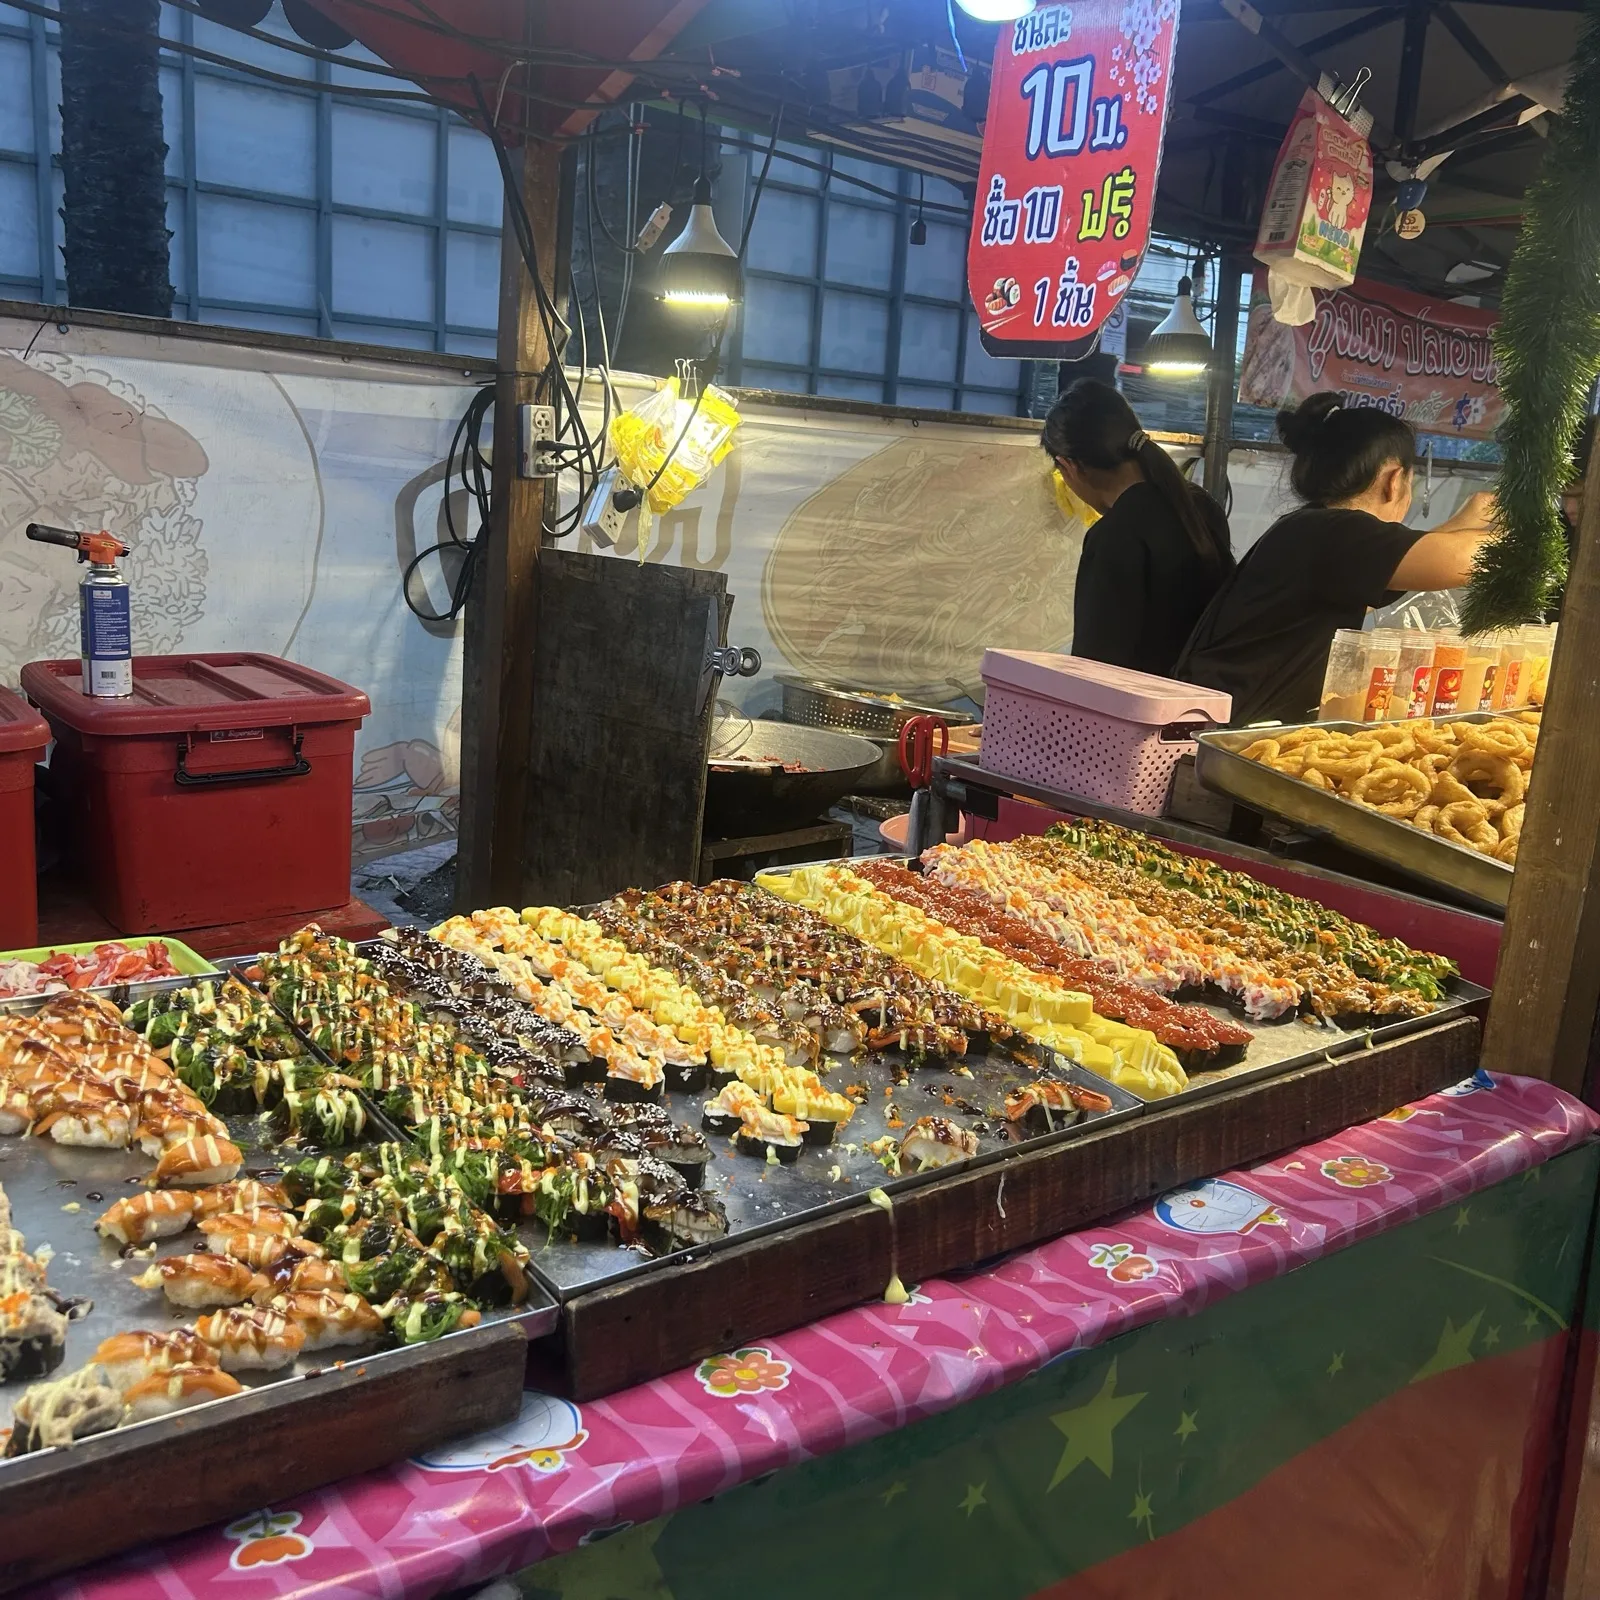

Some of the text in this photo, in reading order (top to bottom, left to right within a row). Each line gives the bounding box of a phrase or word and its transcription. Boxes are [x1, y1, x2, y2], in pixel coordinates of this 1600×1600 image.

[1013, 5, 1072, 54] ชนละ
[1022, 59, 1092, 157] 10
[1024, 186, 1062, 243] 10
[1078, 167, 1135, 242] ฟรี
[1318, 220, 1350, 249] NEKO
[1035, 257, 1095, 326] 1 ชิ้น
